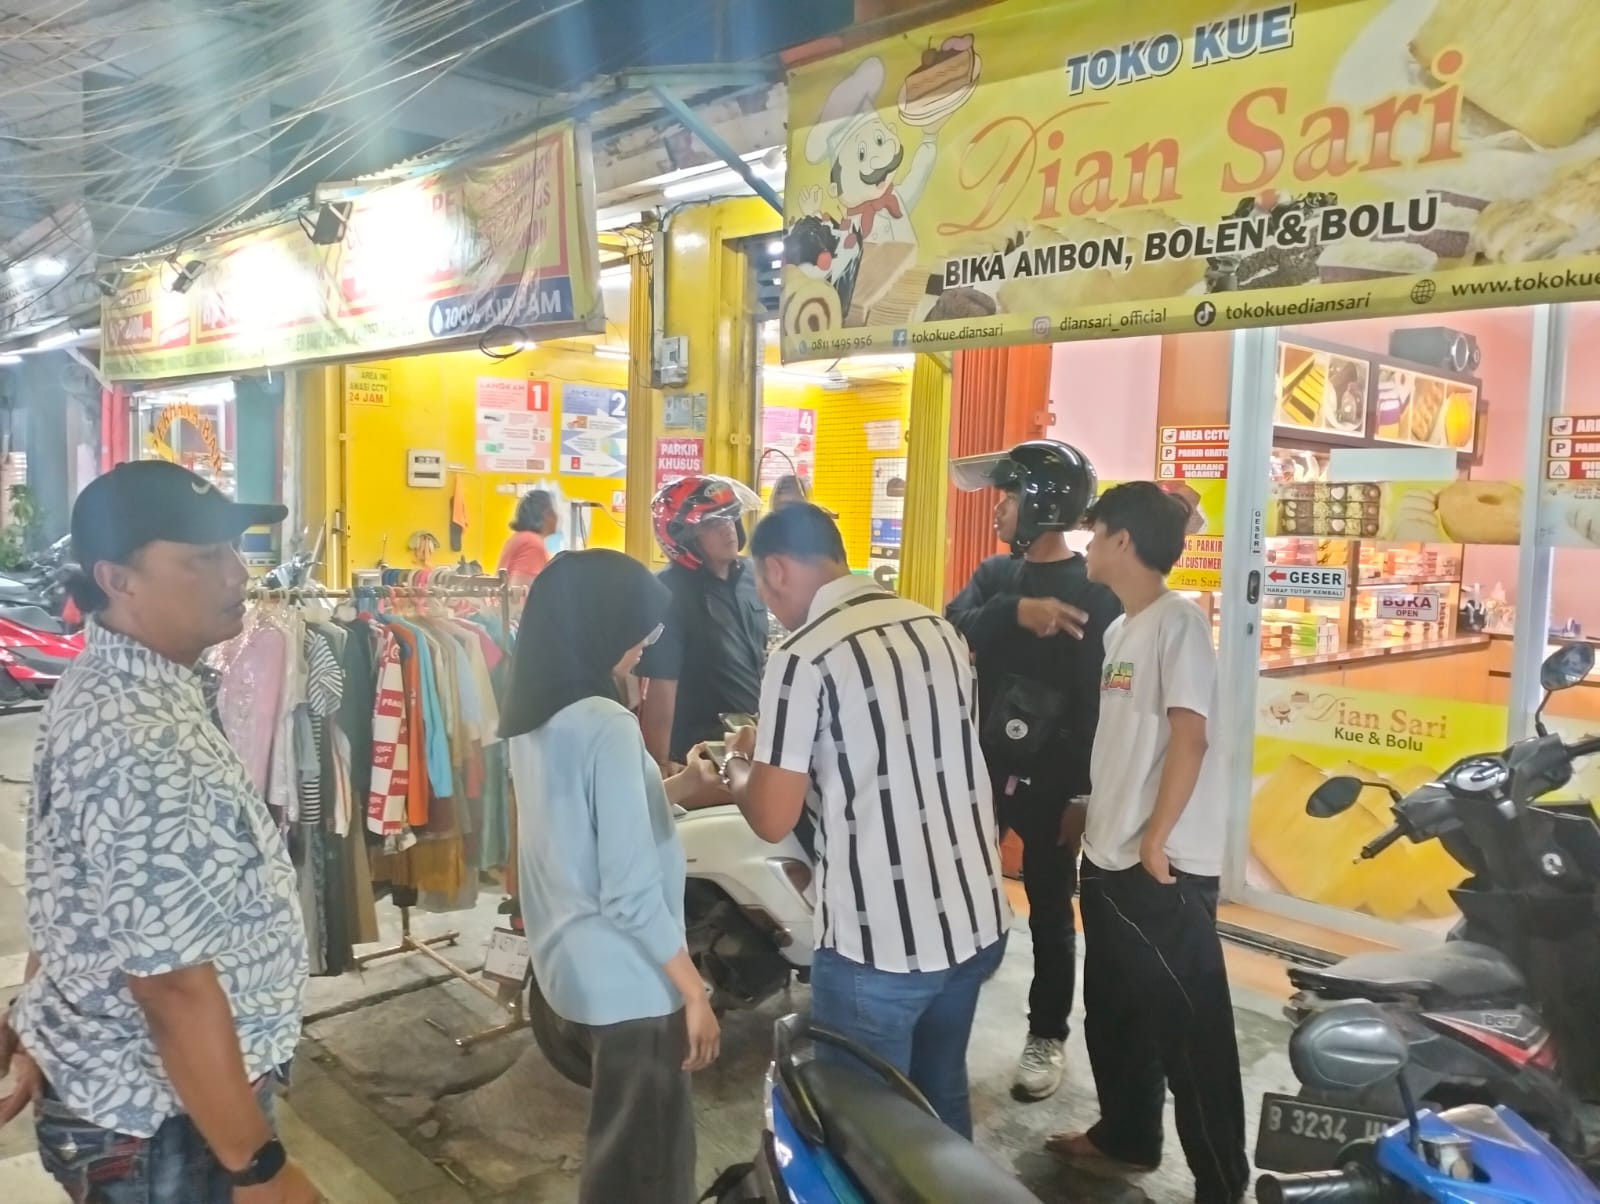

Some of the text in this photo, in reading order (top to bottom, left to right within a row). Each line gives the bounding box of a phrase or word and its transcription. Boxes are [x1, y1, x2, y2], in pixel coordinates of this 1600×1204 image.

[1065, 3, 1296, 95] TOKO KUE
[937, 48, 1464, 236] Dian Sari
[944, 196, 1439, 288] BIKA AMBON, BOLEN & BOLU
[911, 323, 1004, 344] tokokue.diansari
[1059, 308, 1167, 332] diansari_official
[1226, 292, 1372, 320] tokokuediansari
[362, 393, 384, 404] JAM
[531, 384, 543, 410] 1
[611, 392, 626, 417] 2
[799, 411, 813, 433] 4
[1178, 429, 1203, 441] AREA
[660, 443, 698, 457] PARKIR
[658, 458, 700, 471] KHUSUS
[1196, 540, 1223, 552] PARKIR
[1185, 556, 1222, 570] CUSTOMER
[1289, 571, 1342, 586] GESER
[1382, 595, 1432, 609] BUKA
[1395, 609, 1419, 618] OPEN
[1304, 692, 1448, 739] Dian Sari
[1333, 727, 1423, 752] Kue & Bolu
[1268, 1105, 1283, 1132] B
[1290, 1109, 1348, 1144] 3234
